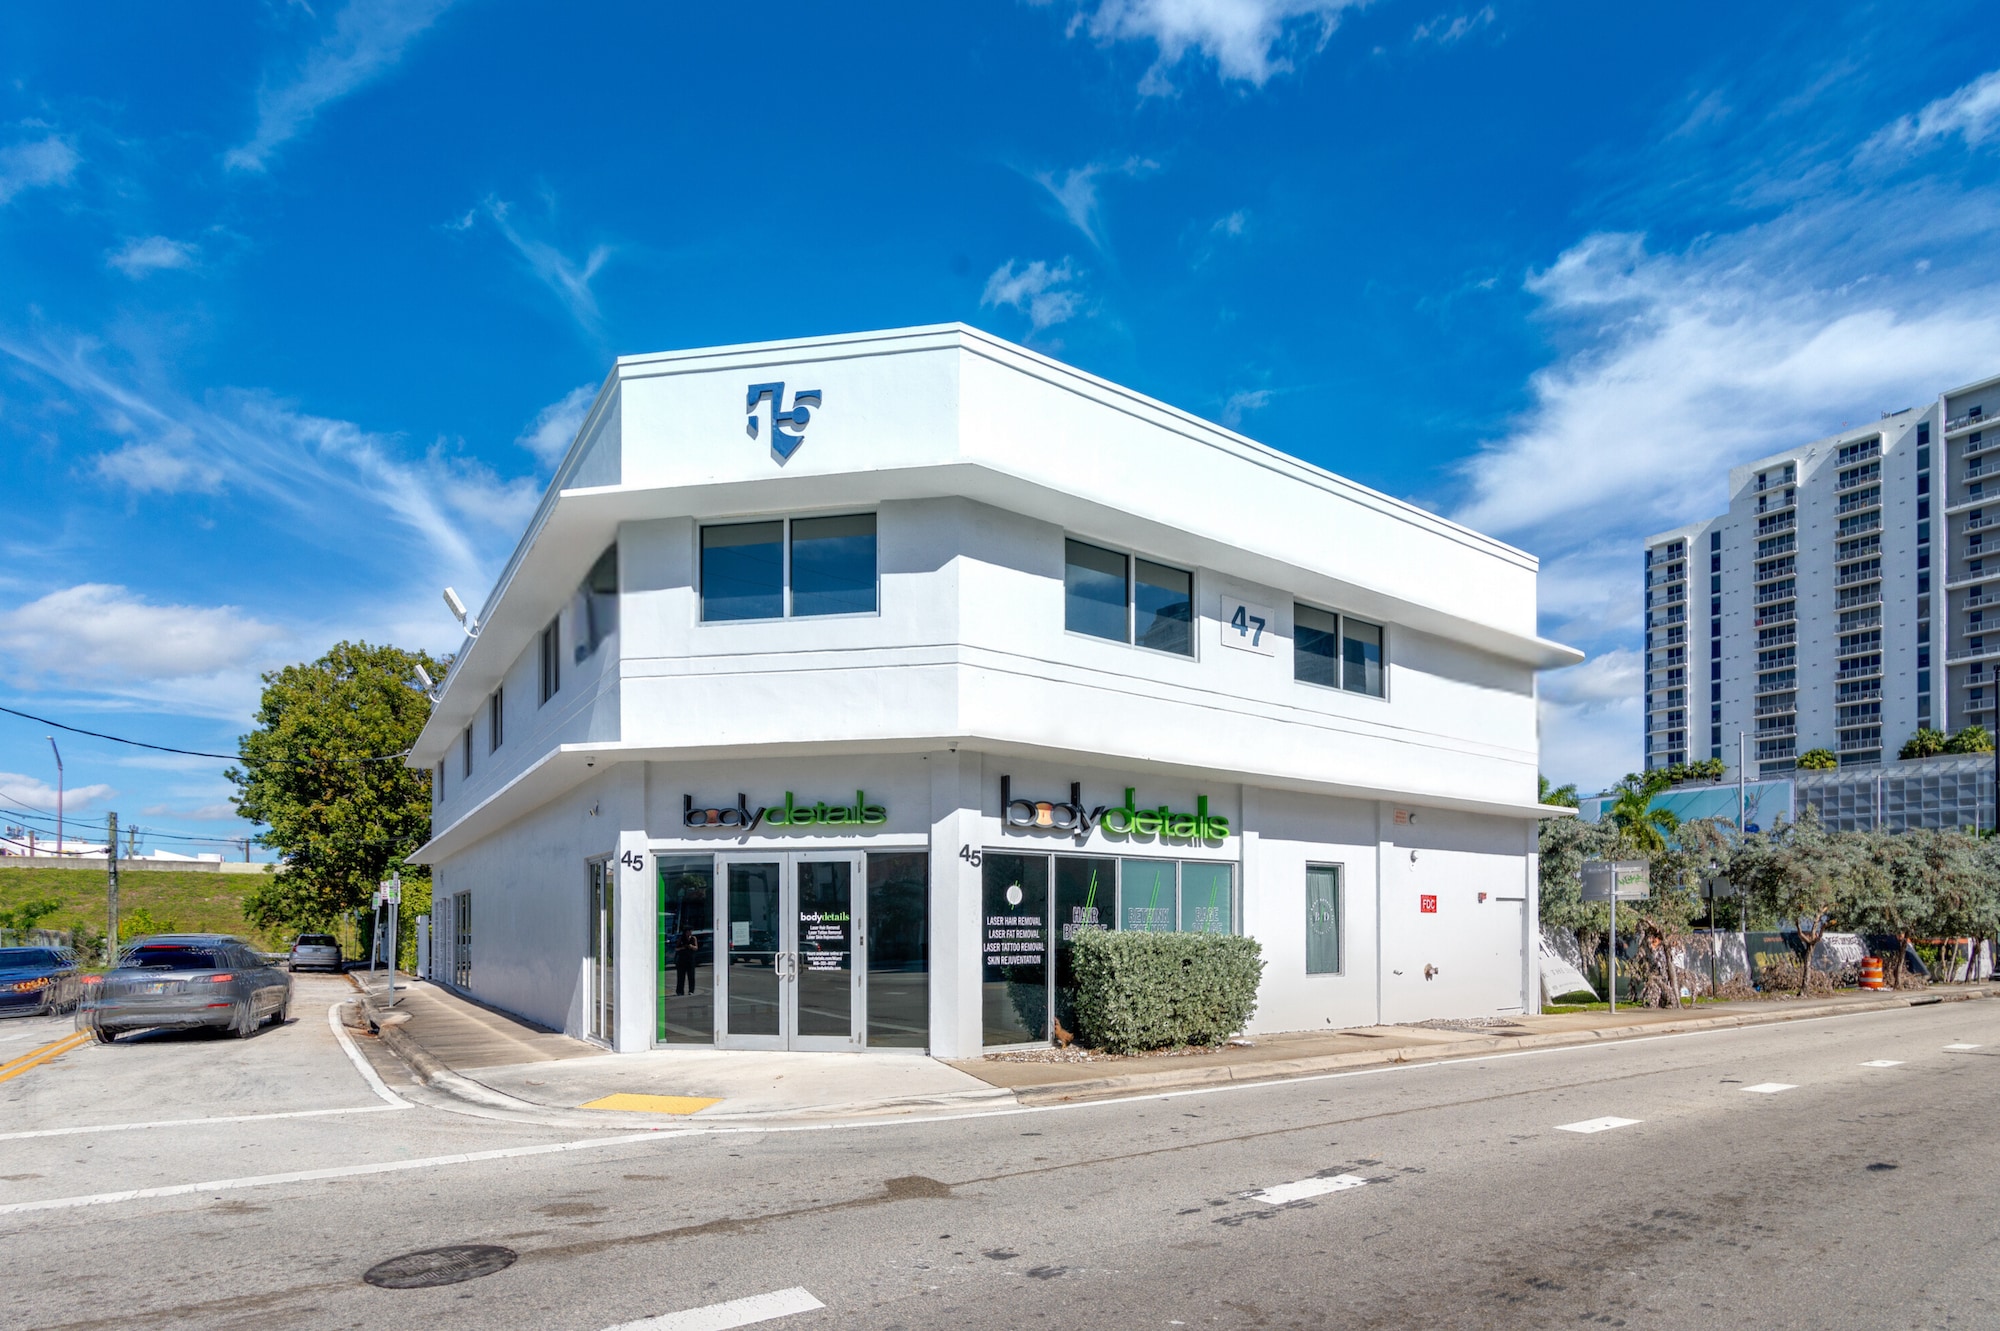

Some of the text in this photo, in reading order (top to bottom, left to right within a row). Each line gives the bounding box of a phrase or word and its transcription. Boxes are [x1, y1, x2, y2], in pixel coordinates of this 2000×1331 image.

[1231, 605, 1266, 647] 47
[620, 850, 644, 871] 45
[959, 844, 981, 867] 45
[1422, 899, 1435, 910] FDC
[800, 911, 850, 924] bodydetails
[1073, 906, 1099, 923] HAIR
[986, 916, 1042, 926] LASER HAIR REMOVAL
[988, 929, 1040, 939] LASER FAT REMOVAL
[983, 942, 1045, 952] LASER TATTOO REMOVAL
[987, 955, 1000, 965] SKIN
